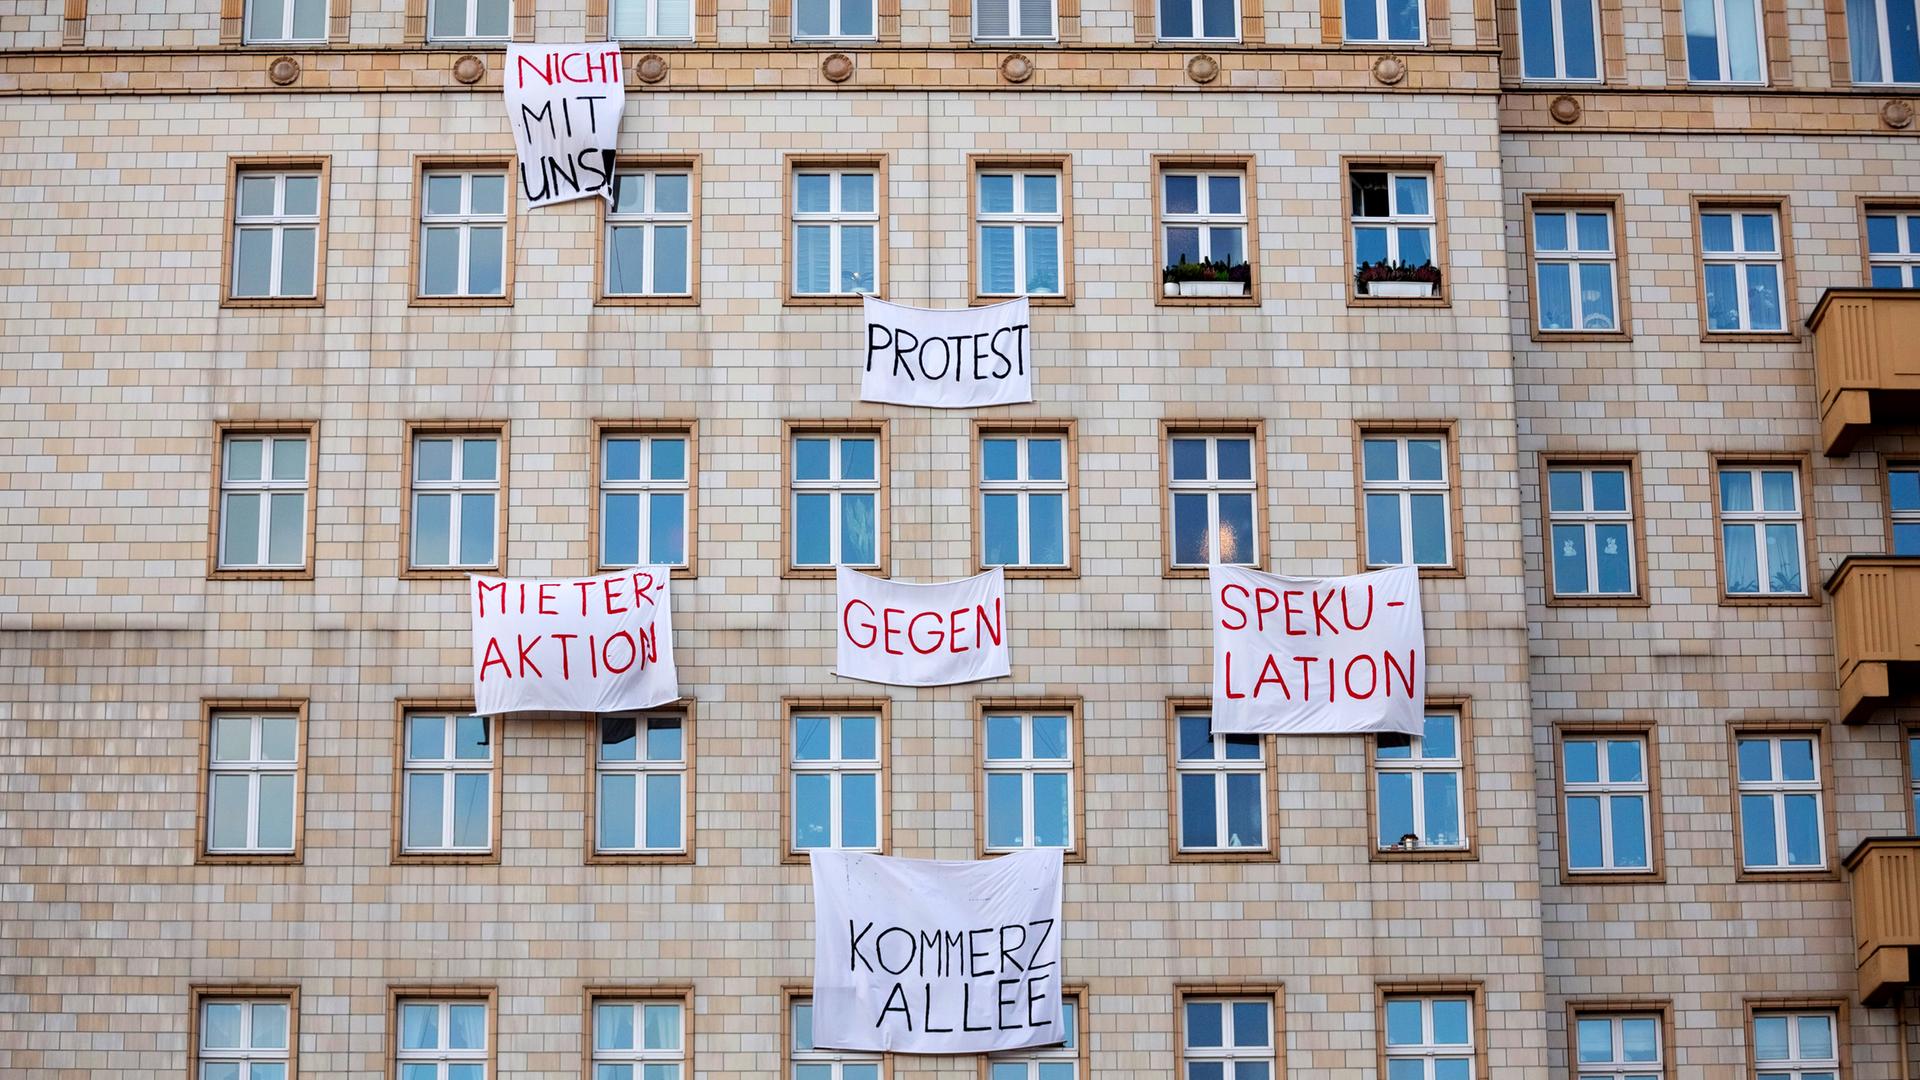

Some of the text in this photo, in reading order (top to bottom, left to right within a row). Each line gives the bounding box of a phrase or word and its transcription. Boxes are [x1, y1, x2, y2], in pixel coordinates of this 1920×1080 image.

[517, 51, 620, 89] NICHT
[521, 96, 607, 145] MIT
[520, 147, 617, 202] UNS!
[866, 323, 1029, 382] PROTEST
[477, 572, 665, 618] MIETER-
[479, 621, 658, 682] AKTION
[843, 597, 1001, 655] GEGEN
[1225, 648, 1416, 703] LATION
[849, 918, 1057, 978] KOMMERZ
[875, 974, 1052, 1033] ALLEE
